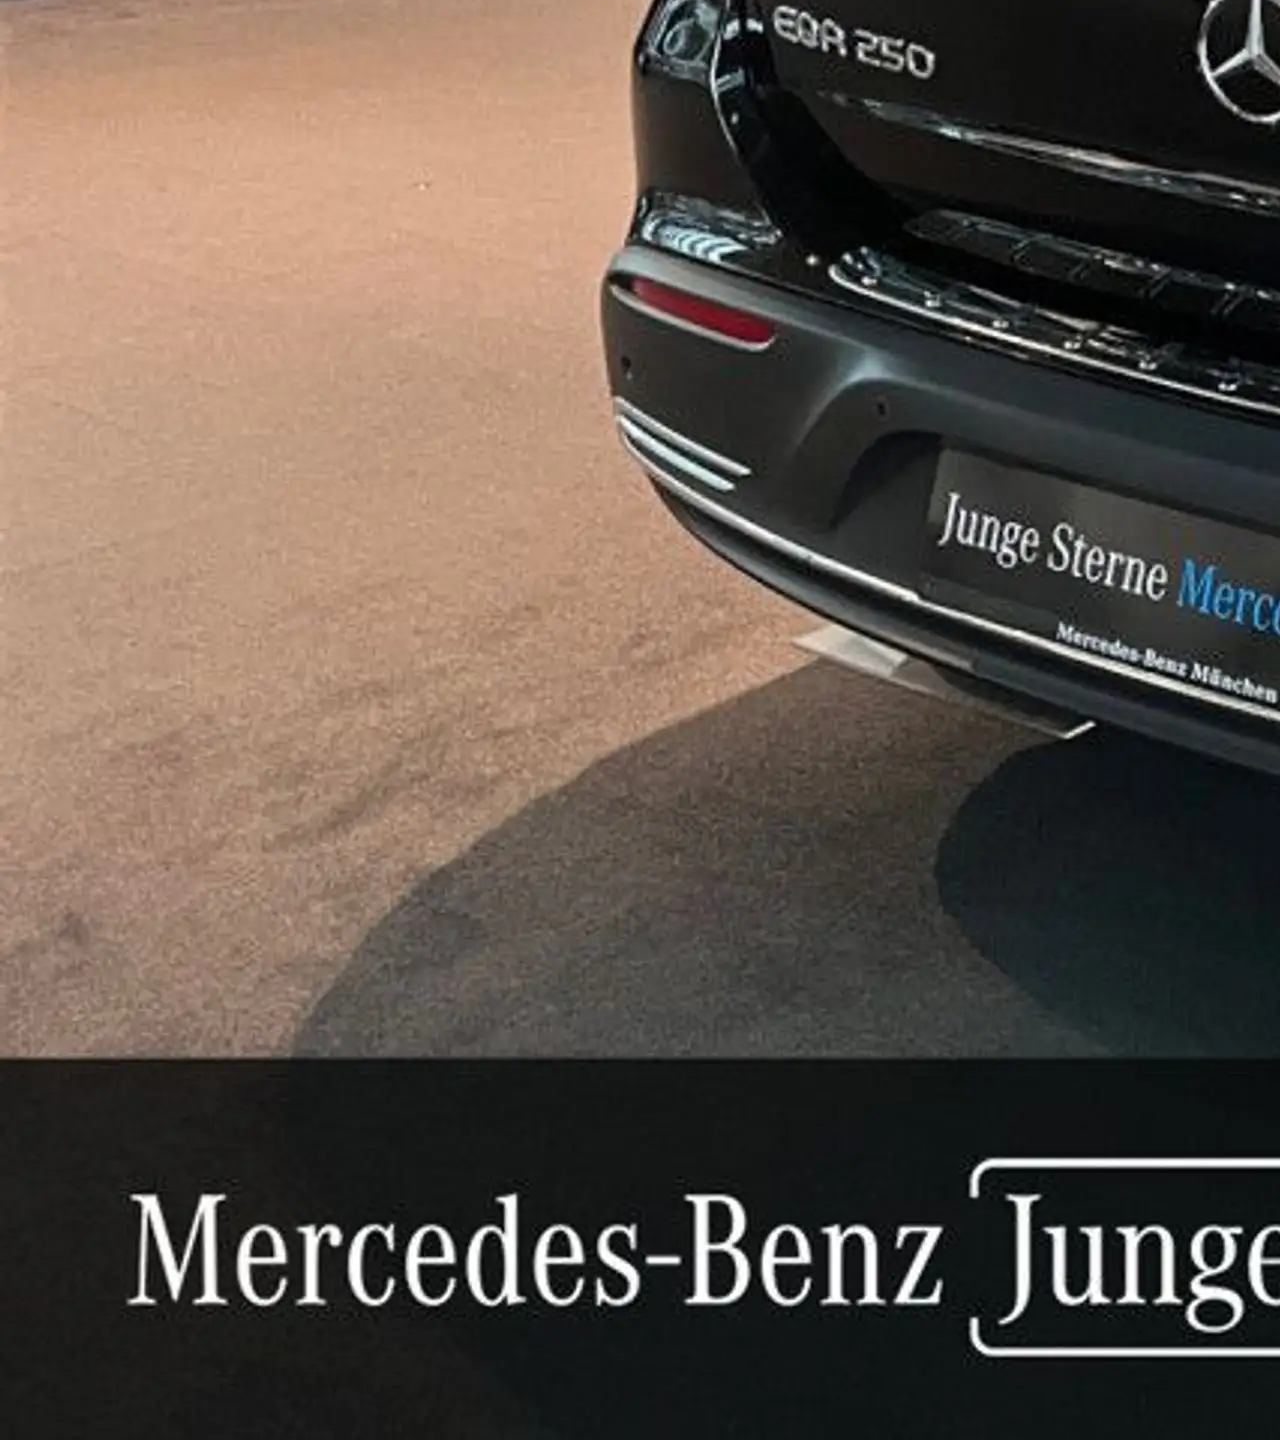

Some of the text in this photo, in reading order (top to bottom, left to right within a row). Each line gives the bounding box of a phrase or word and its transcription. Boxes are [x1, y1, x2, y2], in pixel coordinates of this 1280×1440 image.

[773, 5, 936, 80] EQA 250
[936, 492, 1041, 569] Junge
[1046, 521, 1169, 602] Sterne
[1055, 620, 1280, 704] Mercedes-Benz München
